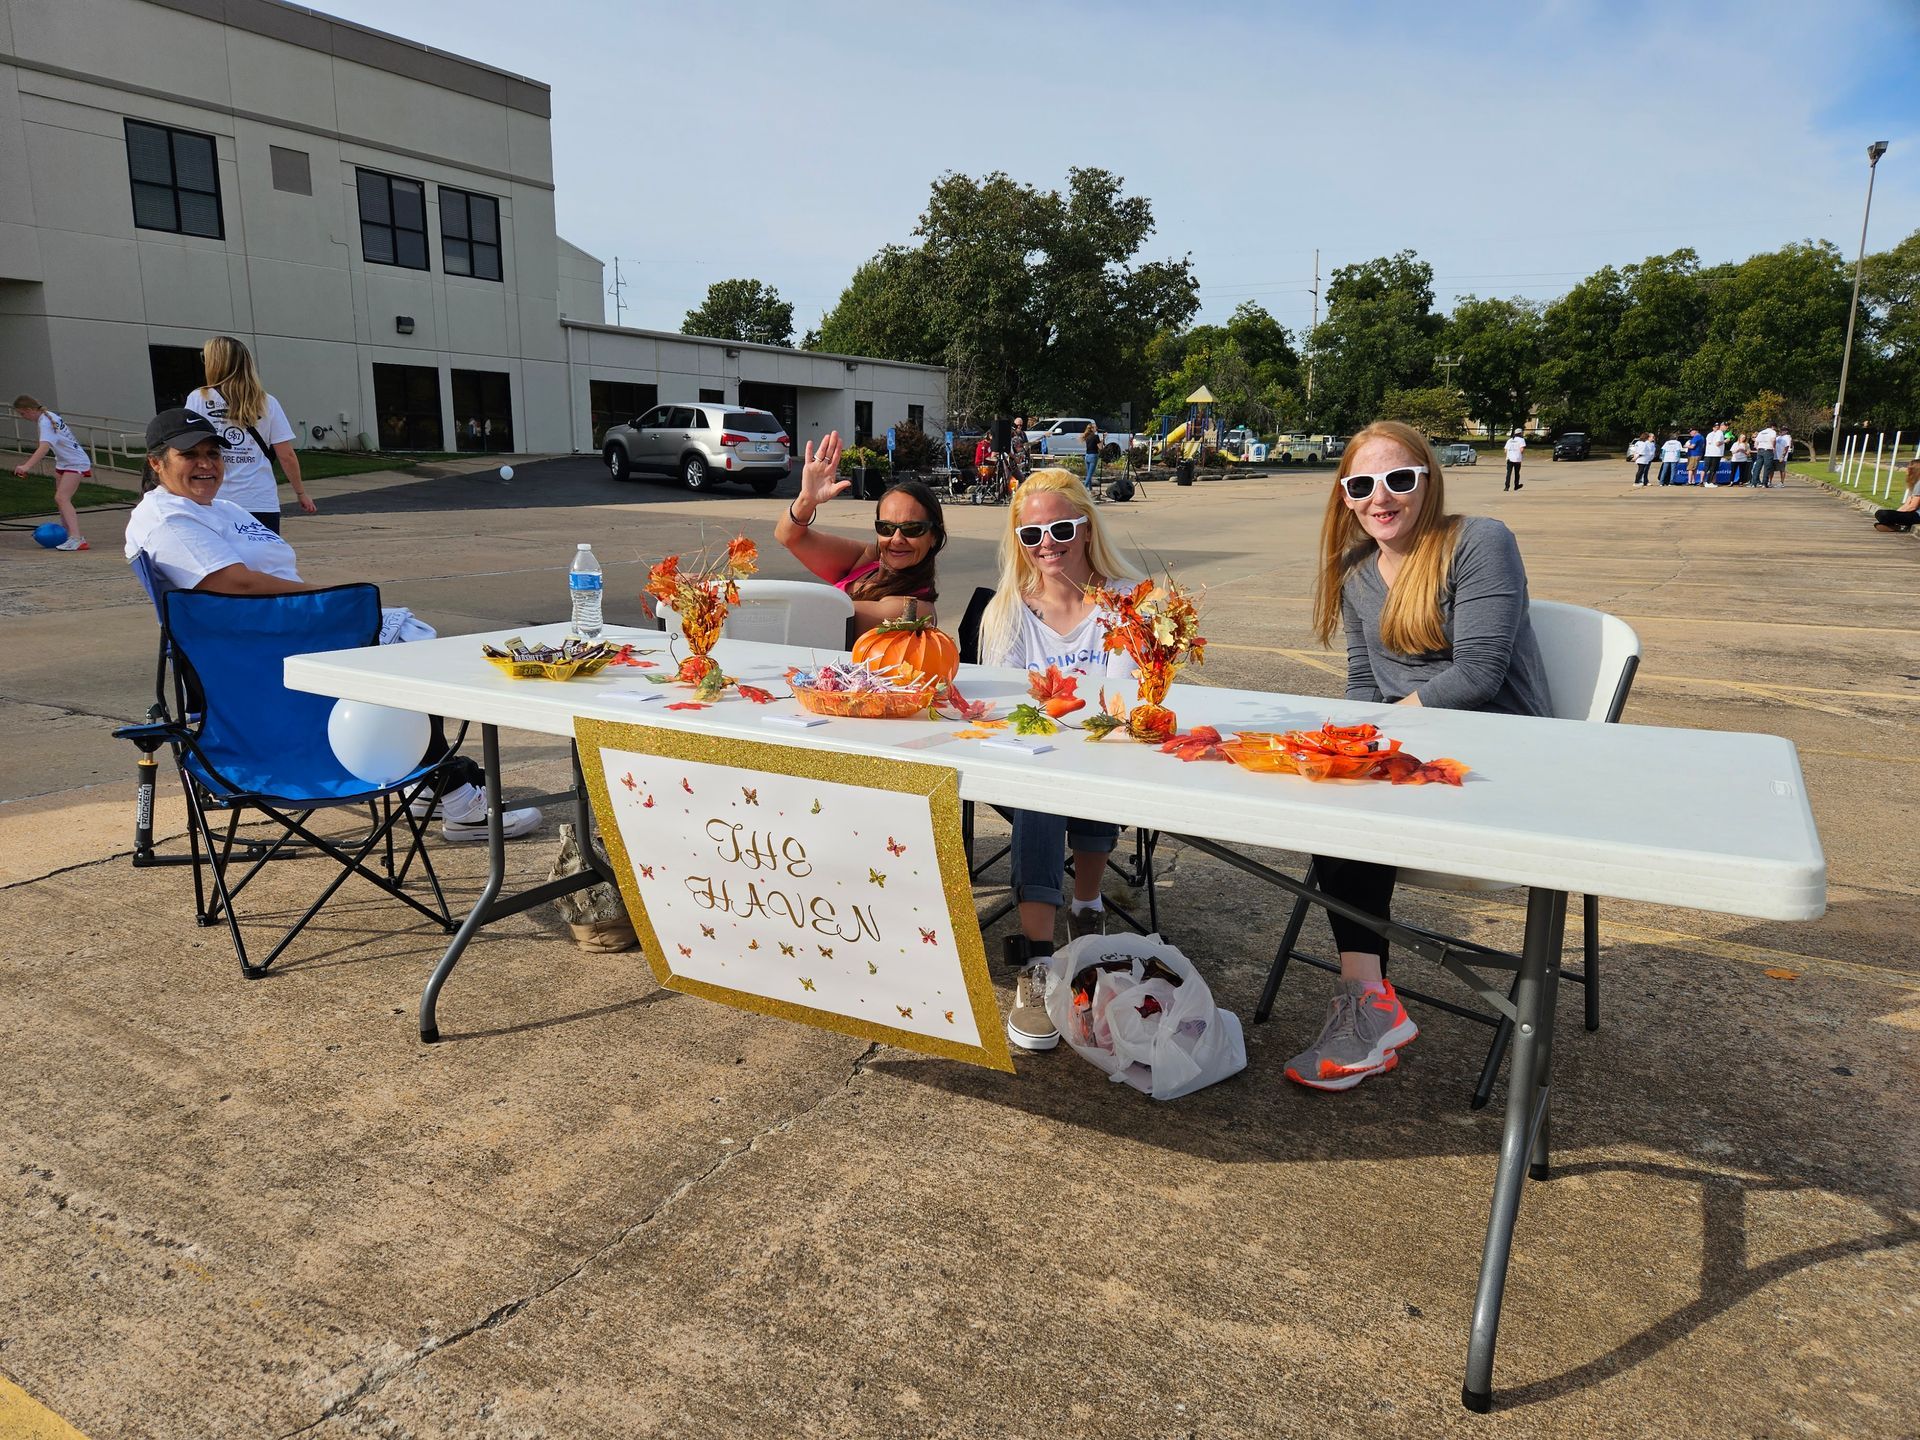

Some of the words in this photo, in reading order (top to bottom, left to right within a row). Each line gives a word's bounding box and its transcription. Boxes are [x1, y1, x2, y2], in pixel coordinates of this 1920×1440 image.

[142, 789, 150, 824] ROCKER
[705, 818, 812, 877] THE
[684, 875, 881, 943] HAVEN
